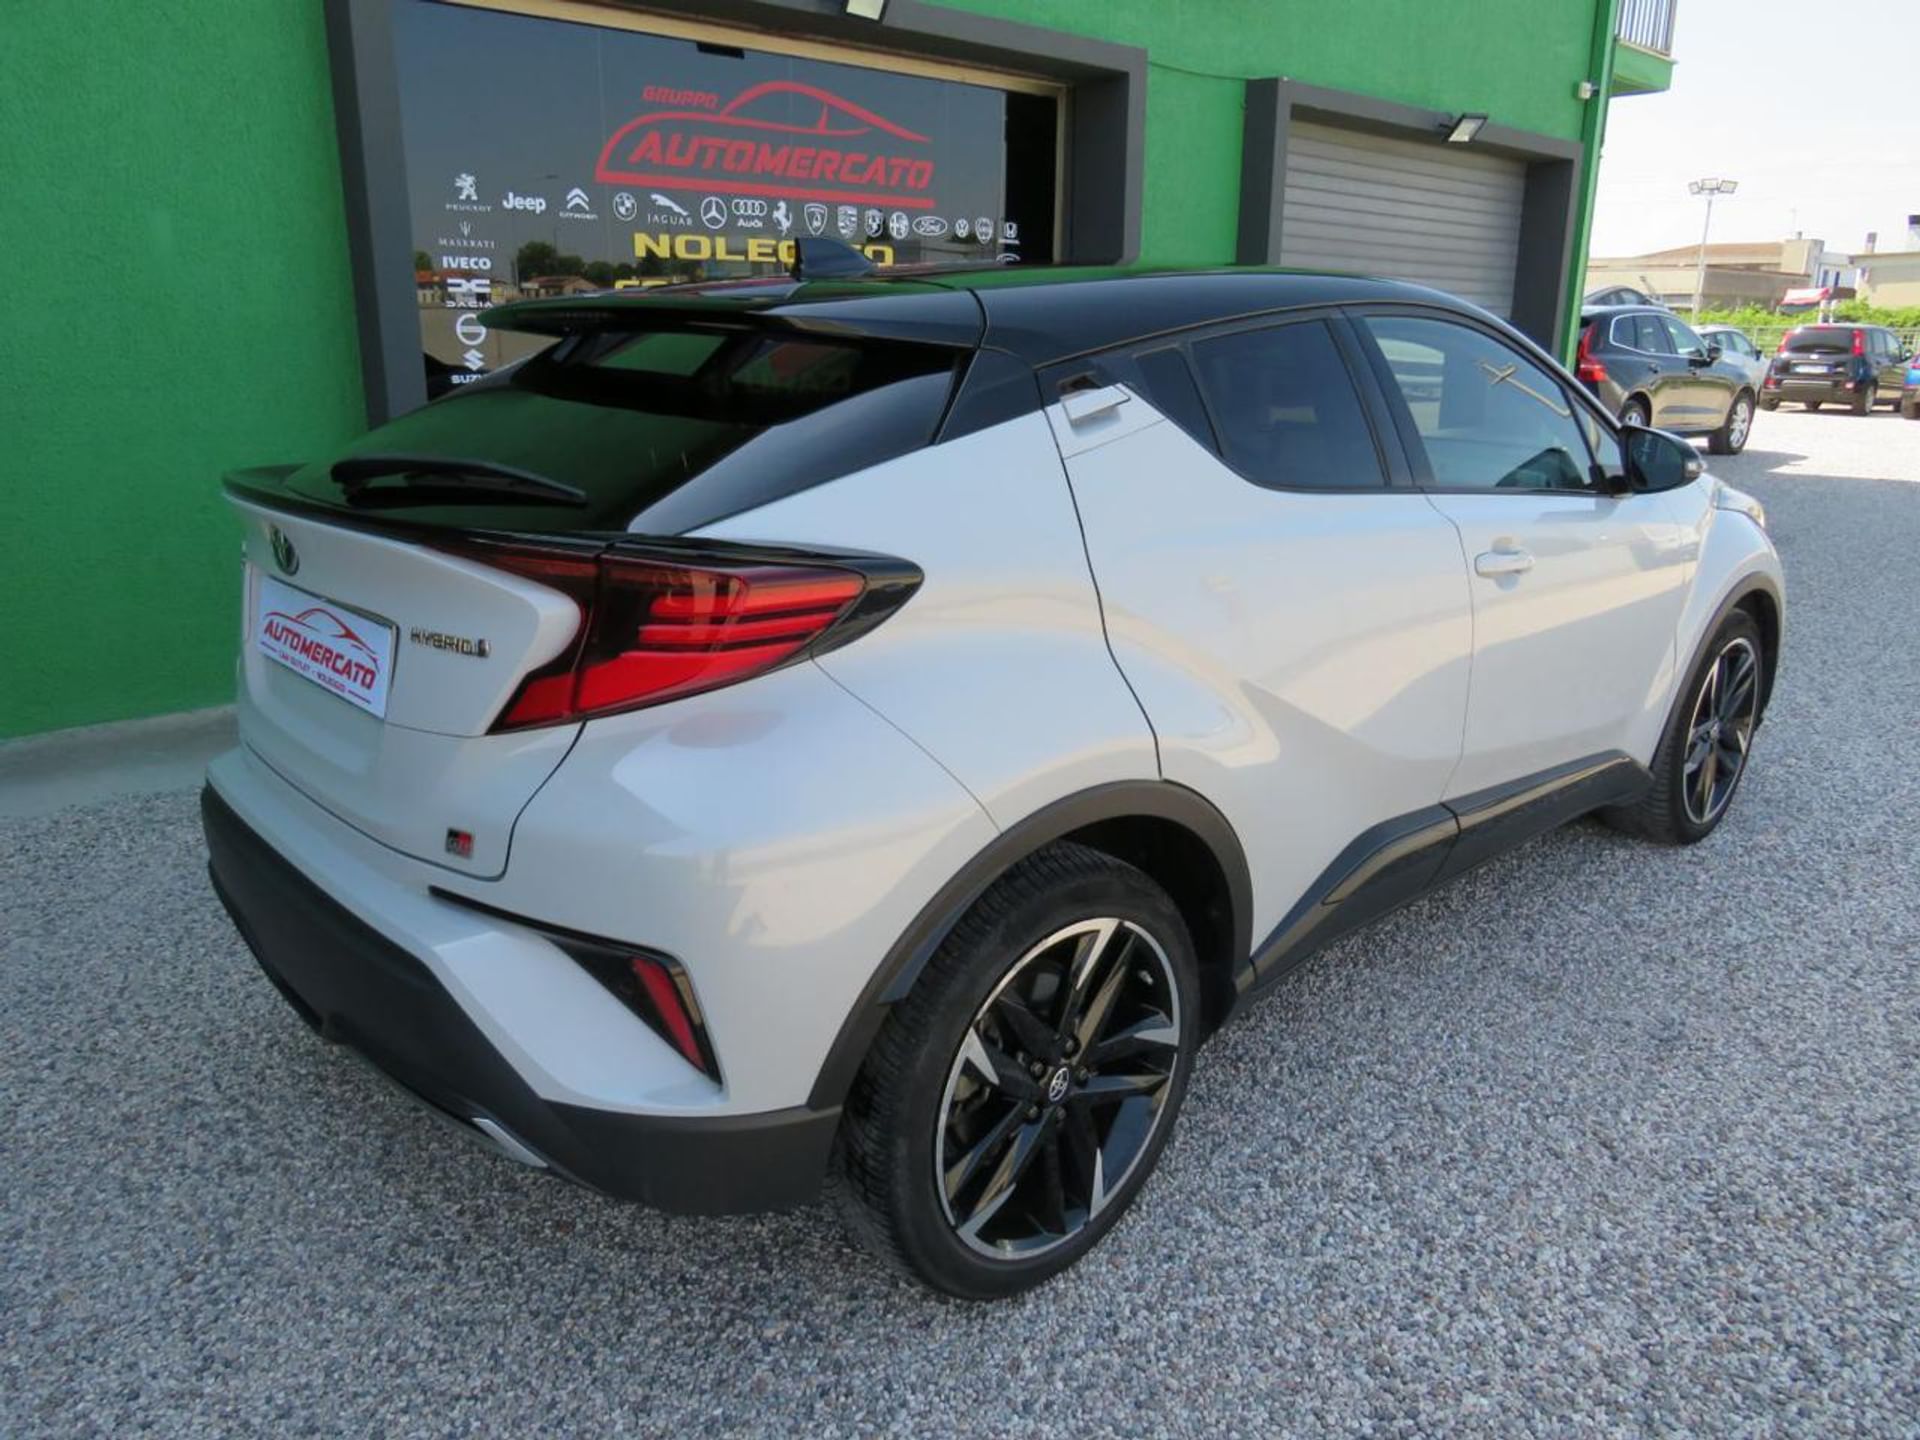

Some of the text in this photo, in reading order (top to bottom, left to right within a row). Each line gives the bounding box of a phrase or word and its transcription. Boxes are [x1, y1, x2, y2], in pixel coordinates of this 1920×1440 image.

[627, 130, 935, 189] AUTOMERCATO
[445, 204, 492, 212] PEUGEOT
[502, 192, 546, 214] Jeep
[647, 214, 693, 226] JAGUAR
[737, 218, 763, 228] Audi
[438, 237, 495, 249] MASERATI
[442, 256, 492, 270] IVECO
[445, 300, 494, 308] DACIA
[411, 626, 473, 656] HYBRID
[263, 619, 377, 690] AUTOMERCATO
